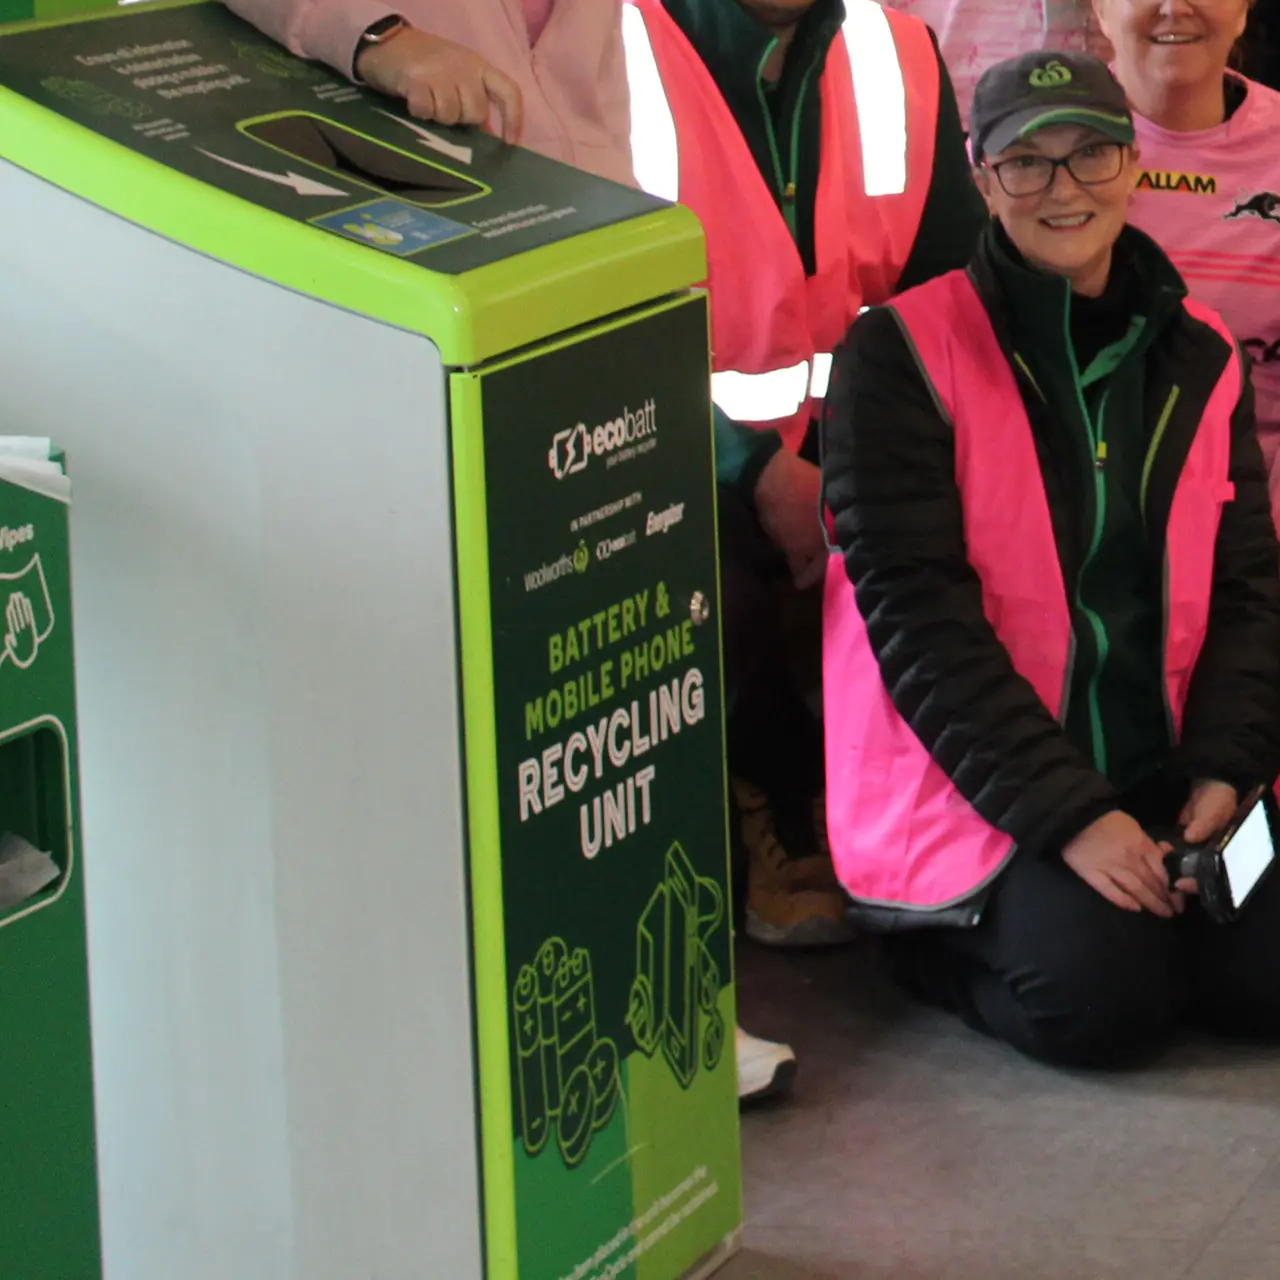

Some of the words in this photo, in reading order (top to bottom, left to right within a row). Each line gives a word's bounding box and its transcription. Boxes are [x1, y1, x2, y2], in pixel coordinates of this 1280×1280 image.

[592, 397, 658, 456] ecobatt
[549, 589, 649, 673] BATTERY
[656, 580, 670, 619] &
[524, 660, 615, 741] MOBILE
[620, 619, 696, 689] PHONE
[518, 667, 706, 822] RECYCLING
[579, 764, 656, 860] UNIT
